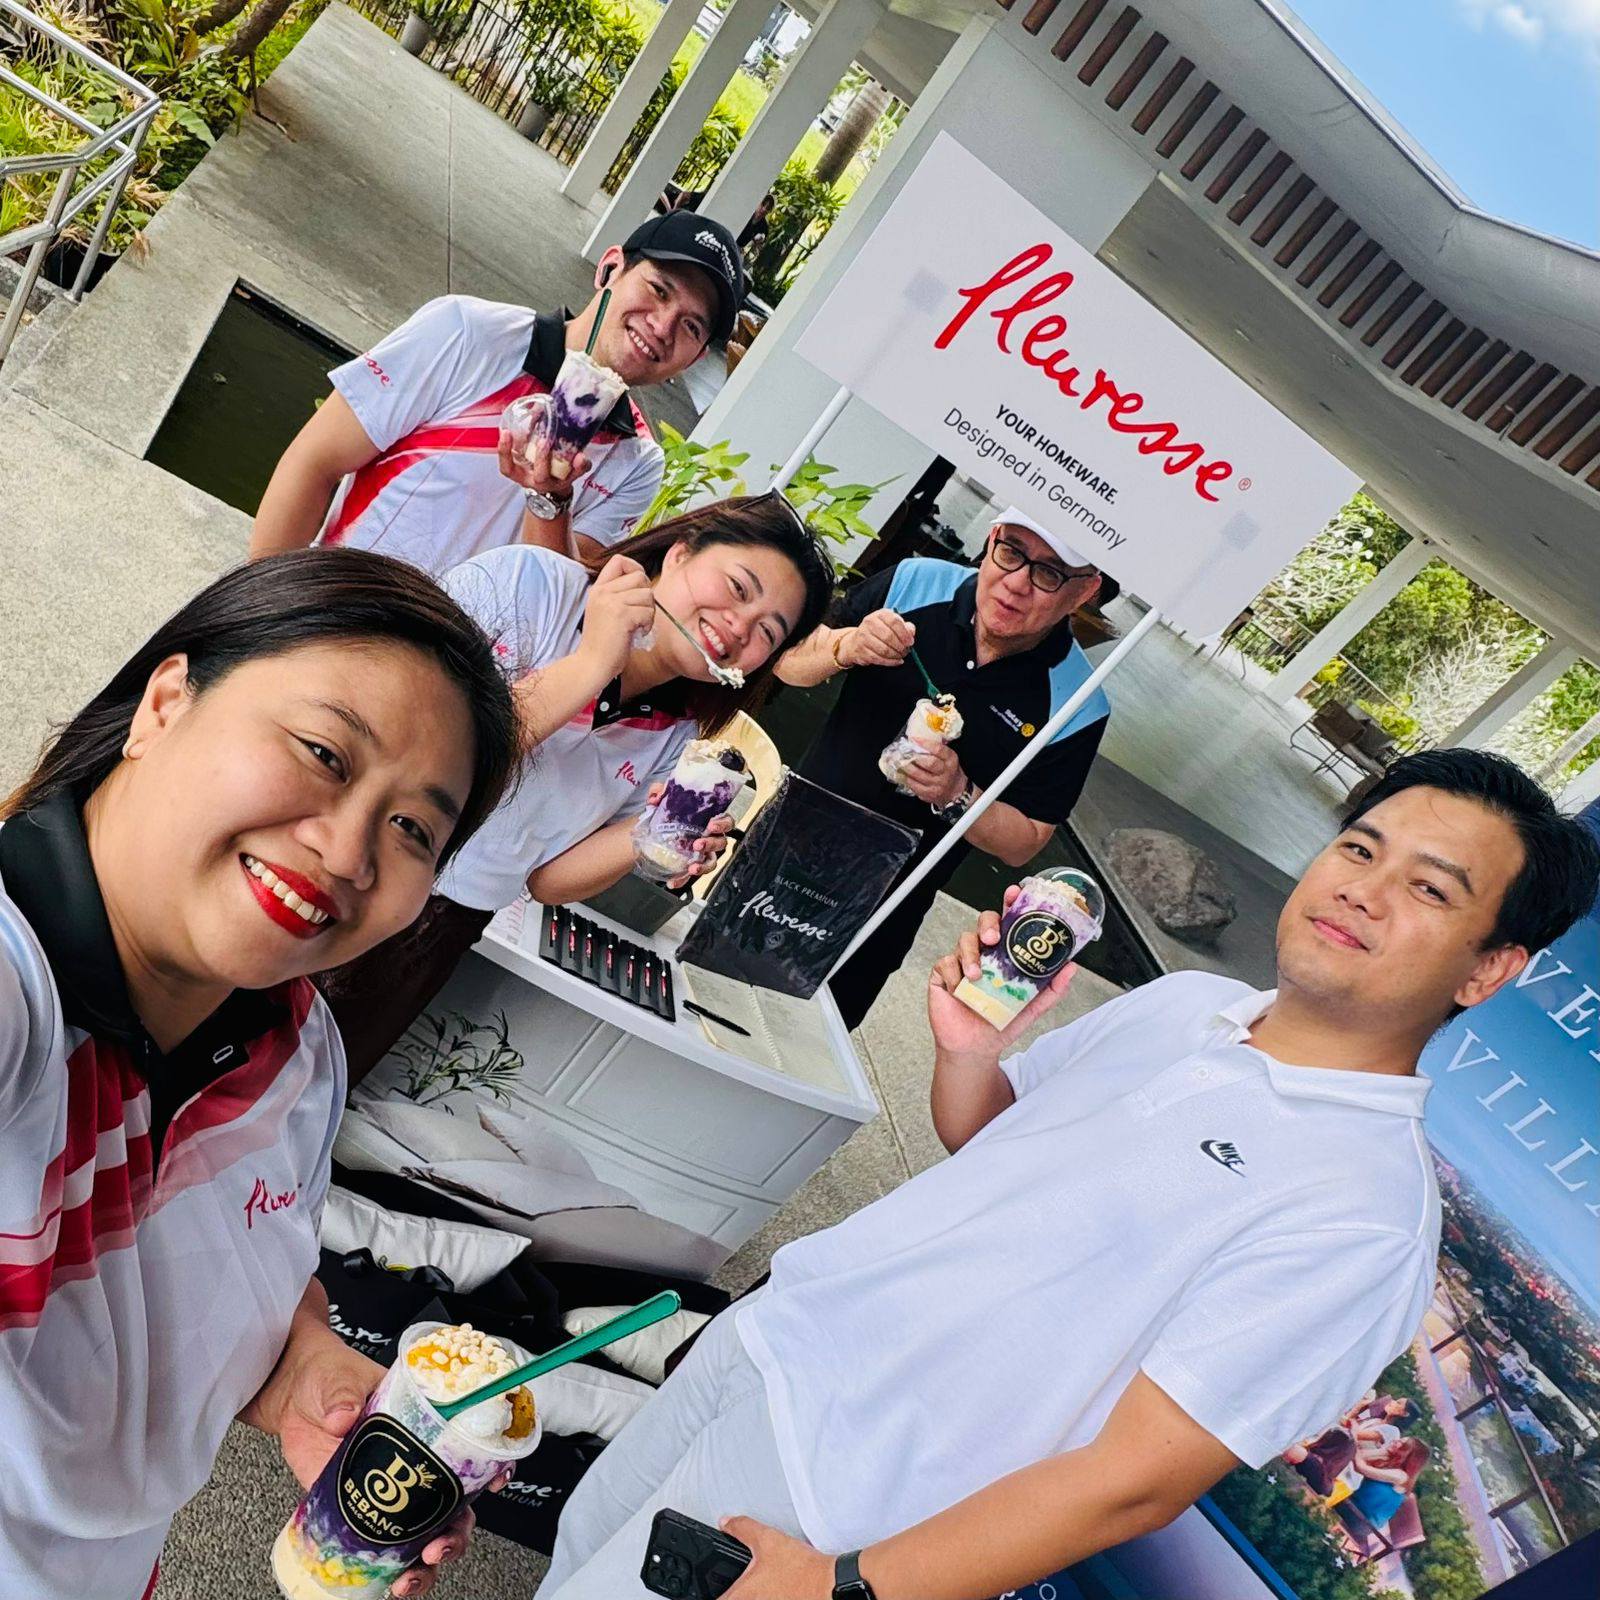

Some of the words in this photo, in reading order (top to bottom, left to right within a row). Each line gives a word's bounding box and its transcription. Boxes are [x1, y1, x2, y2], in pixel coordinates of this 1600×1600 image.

[943, 407, 1033, 478] Designed
[1027, 467, 1047, 492] in
[1047, 483, 1127, 551] Germany
[994, 403, 1038, 443] YOUR
[1033, 434, 1119, 505] HOMEWARE.
[774, 874, 800, 892] BLACK
[801, 886, 839, 908] PREMIUM
[1445, 1026, 1600, 1219] VILL
[344, 1477, 405, 1538] BEBANG
[346, 1500, 383, 1536] HALO-HALO
